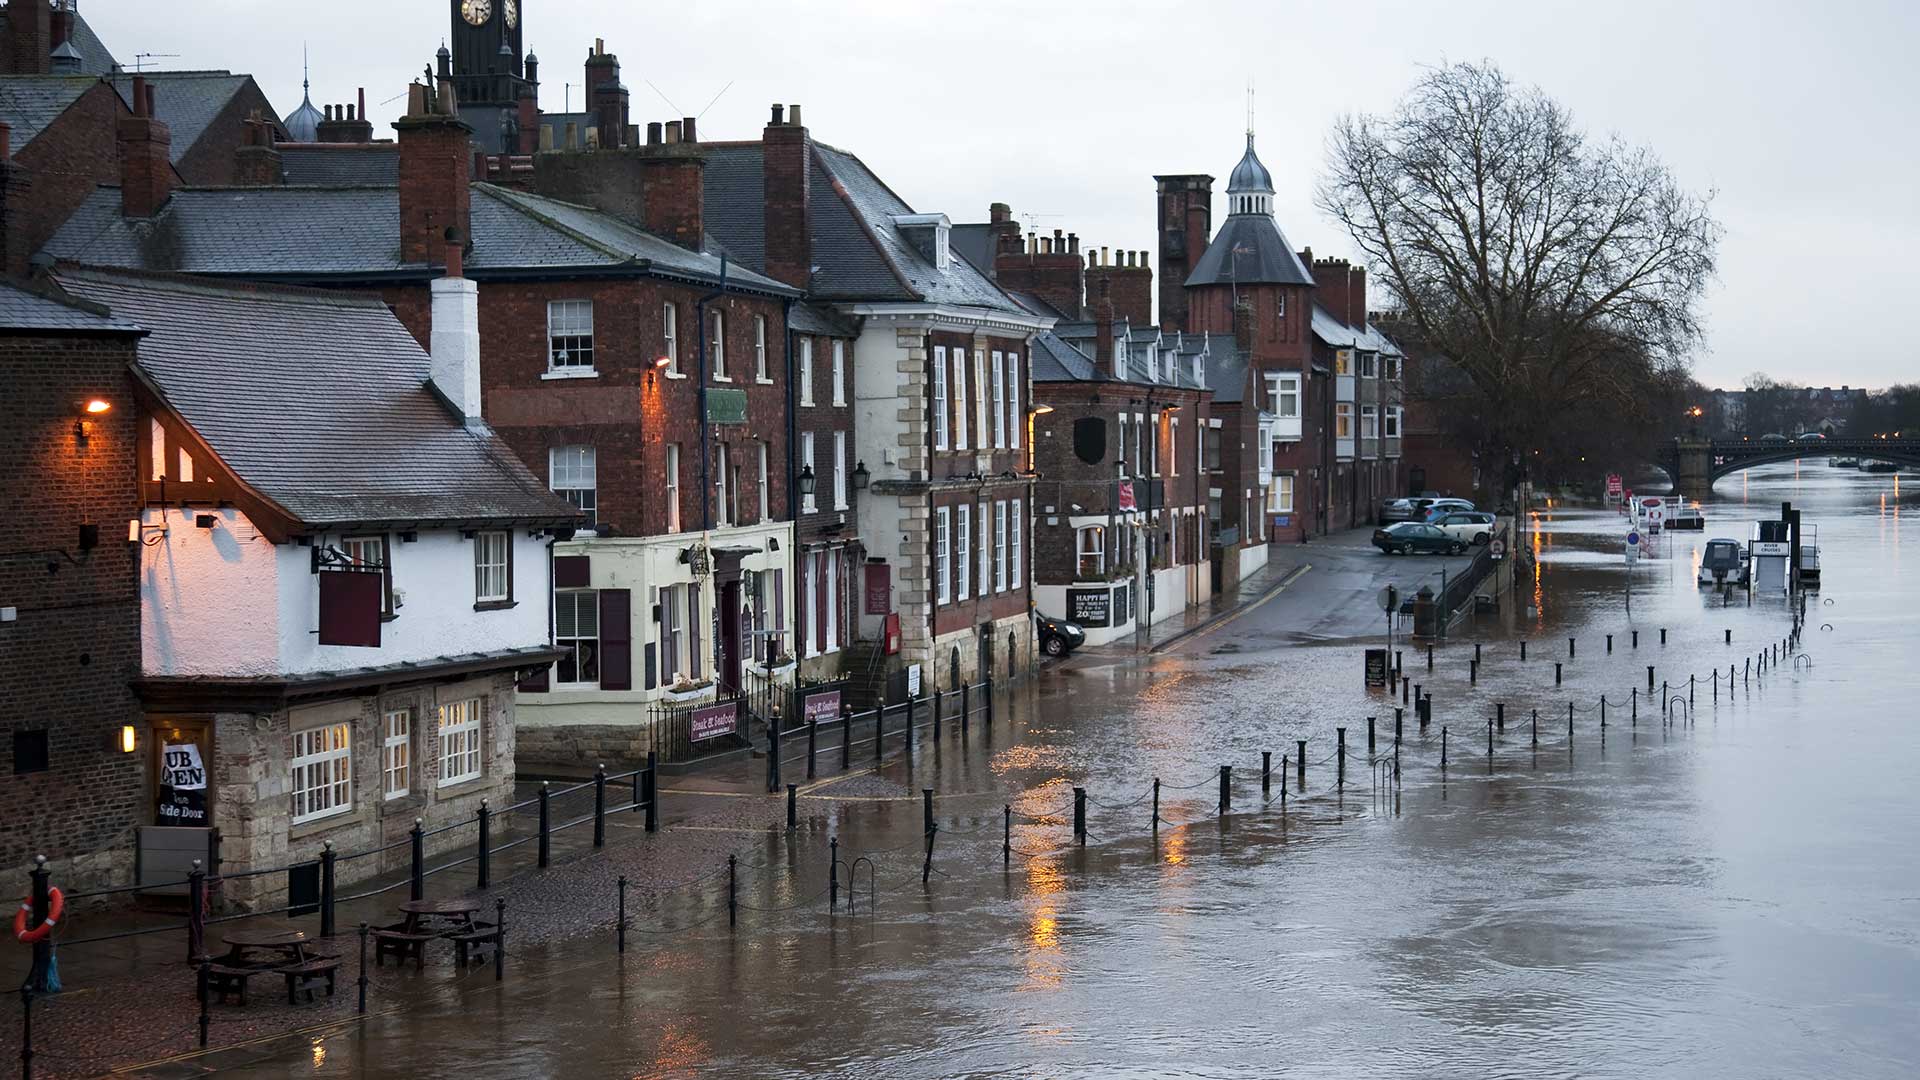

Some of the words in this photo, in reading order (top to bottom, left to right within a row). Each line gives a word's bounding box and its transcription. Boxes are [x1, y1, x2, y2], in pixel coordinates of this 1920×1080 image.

[692, 718, 707, 731] Steak
[707, 717, 714, 728] &
[714, 712, 735, 726] Seafood
[165, 751, 192, 768] UB
[160, 803, 180, 817] Sde
[181, 806, 204, 819] Door
